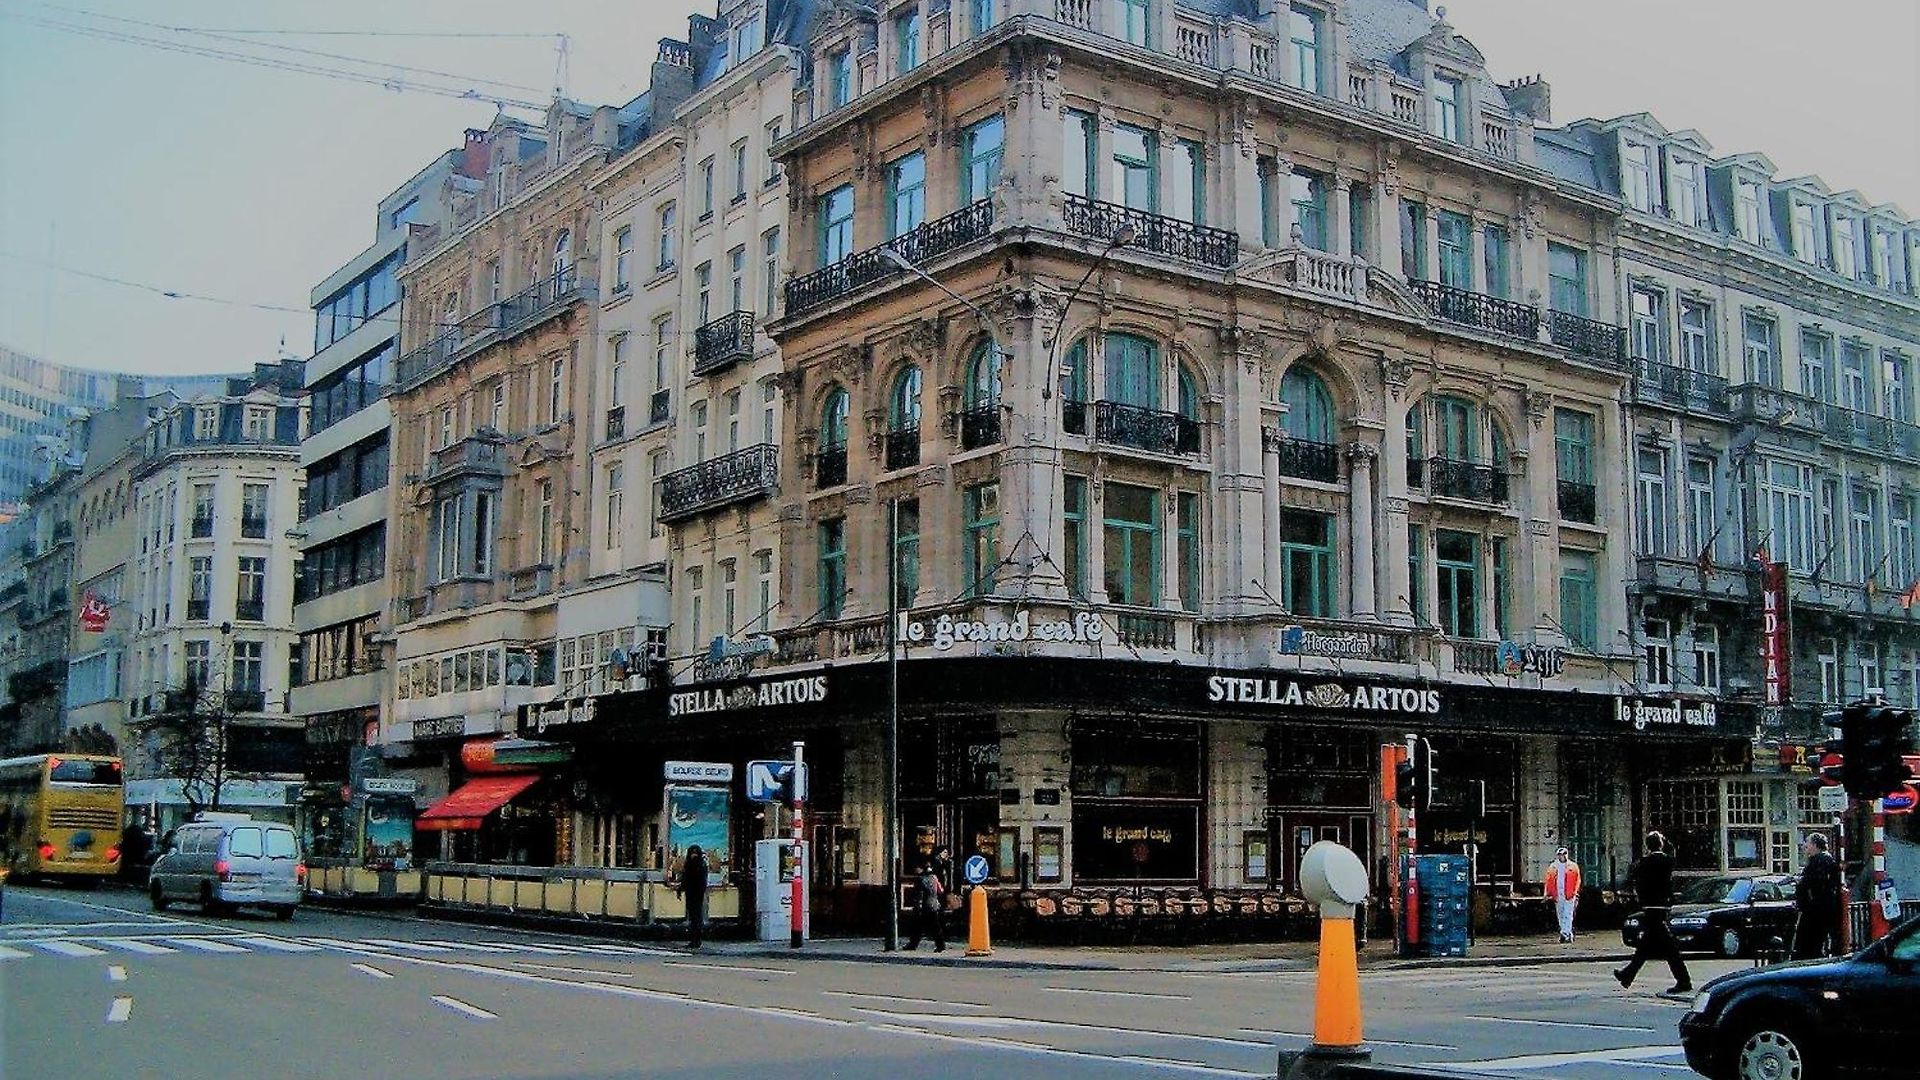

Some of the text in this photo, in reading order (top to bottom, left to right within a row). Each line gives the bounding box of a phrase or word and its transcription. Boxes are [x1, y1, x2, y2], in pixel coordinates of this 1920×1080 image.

[899, 611, 1102, 650] le grand café
[1304, 631, 1370, 654] Hoegaarden
[1763, 590, 1780, 701] NDIAN
[1523, 643, 1564, 677] Leffe
[669, 676, 828, 717] STELLA ARTOIS
[1208, 676, 1440, 714] STELLA ARTOIS
[1613, 696, 1717, 730] le grand café
